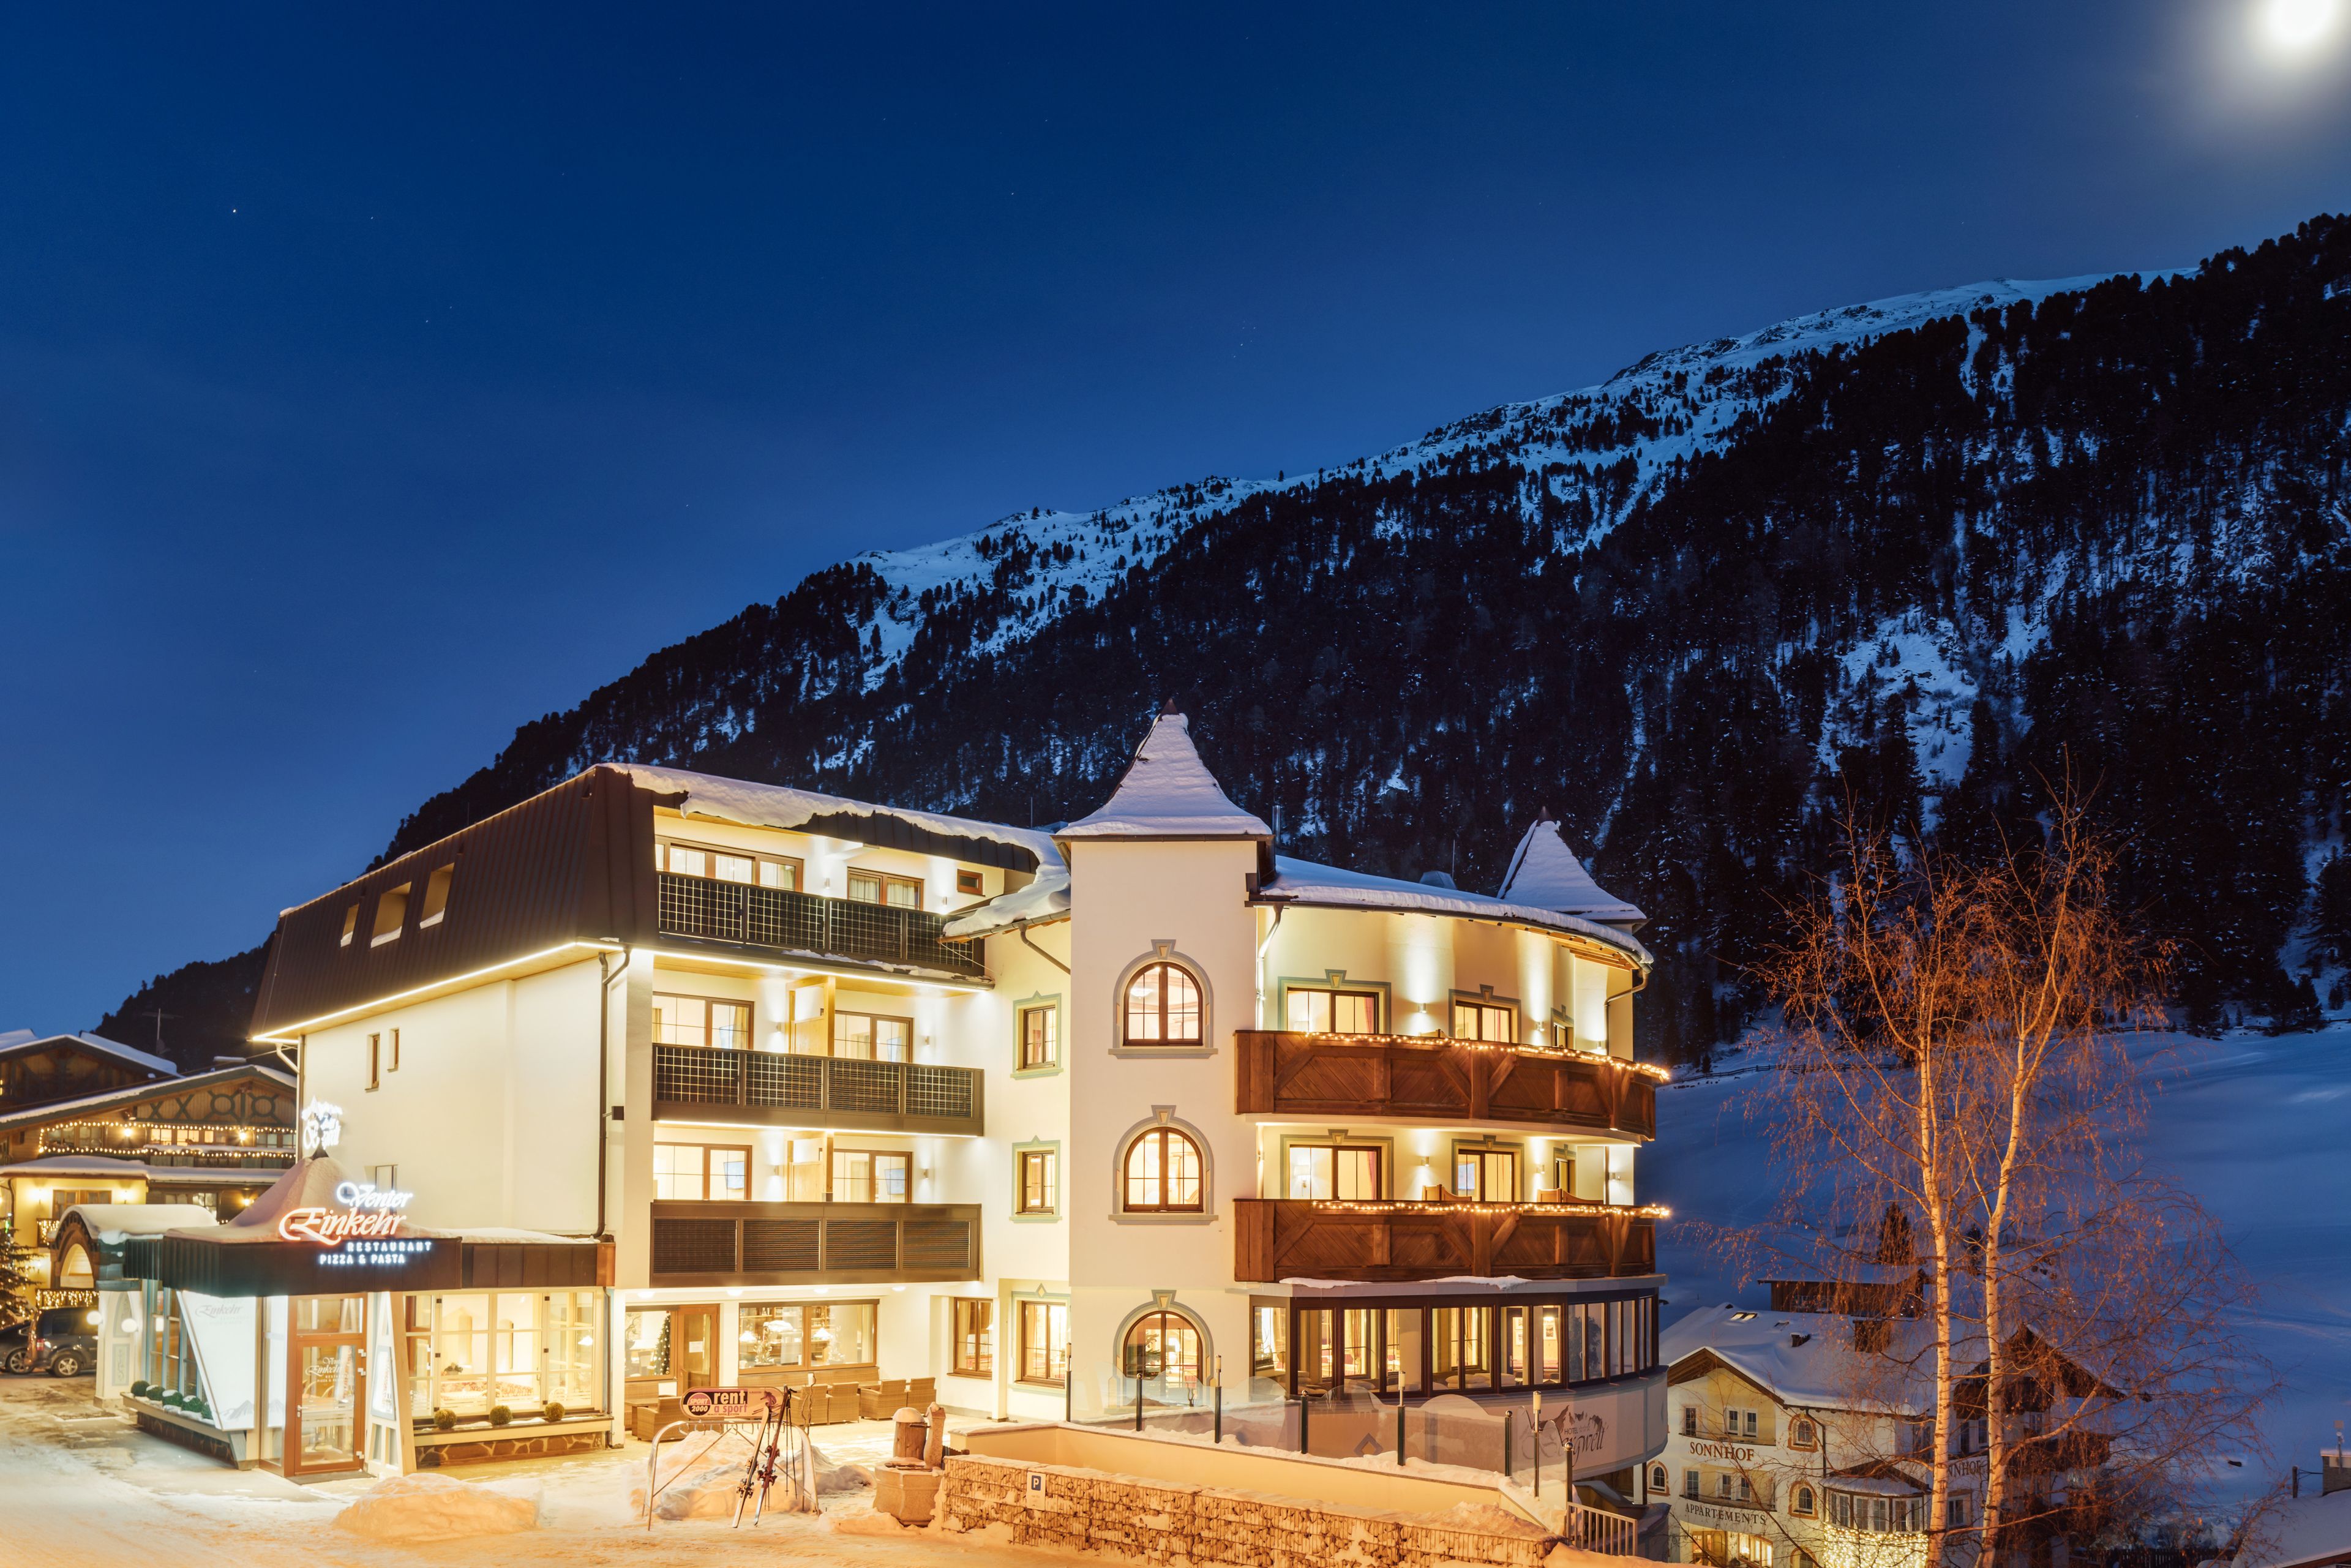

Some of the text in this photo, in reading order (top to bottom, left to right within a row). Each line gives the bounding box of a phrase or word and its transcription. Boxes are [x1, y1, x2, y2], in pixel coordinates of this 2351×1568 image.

[336, 1182, 413, 1208] Venter
[279, 1207, 407, 1245] Einkehr
[347, 1241, 432, 1252] RESTAURANT
[320, 1253, 405, 1265] PIZZA & PASTA
[714, 1390, 745, 1404] rent
[722, 1402, 748, 1416] sport
[1690, 1441, 1755, 1461] SONNHOF
[1033, 1477, 1040, 1488] P
[1685, 1503, 1766, 1526] APPARTEMENTS
